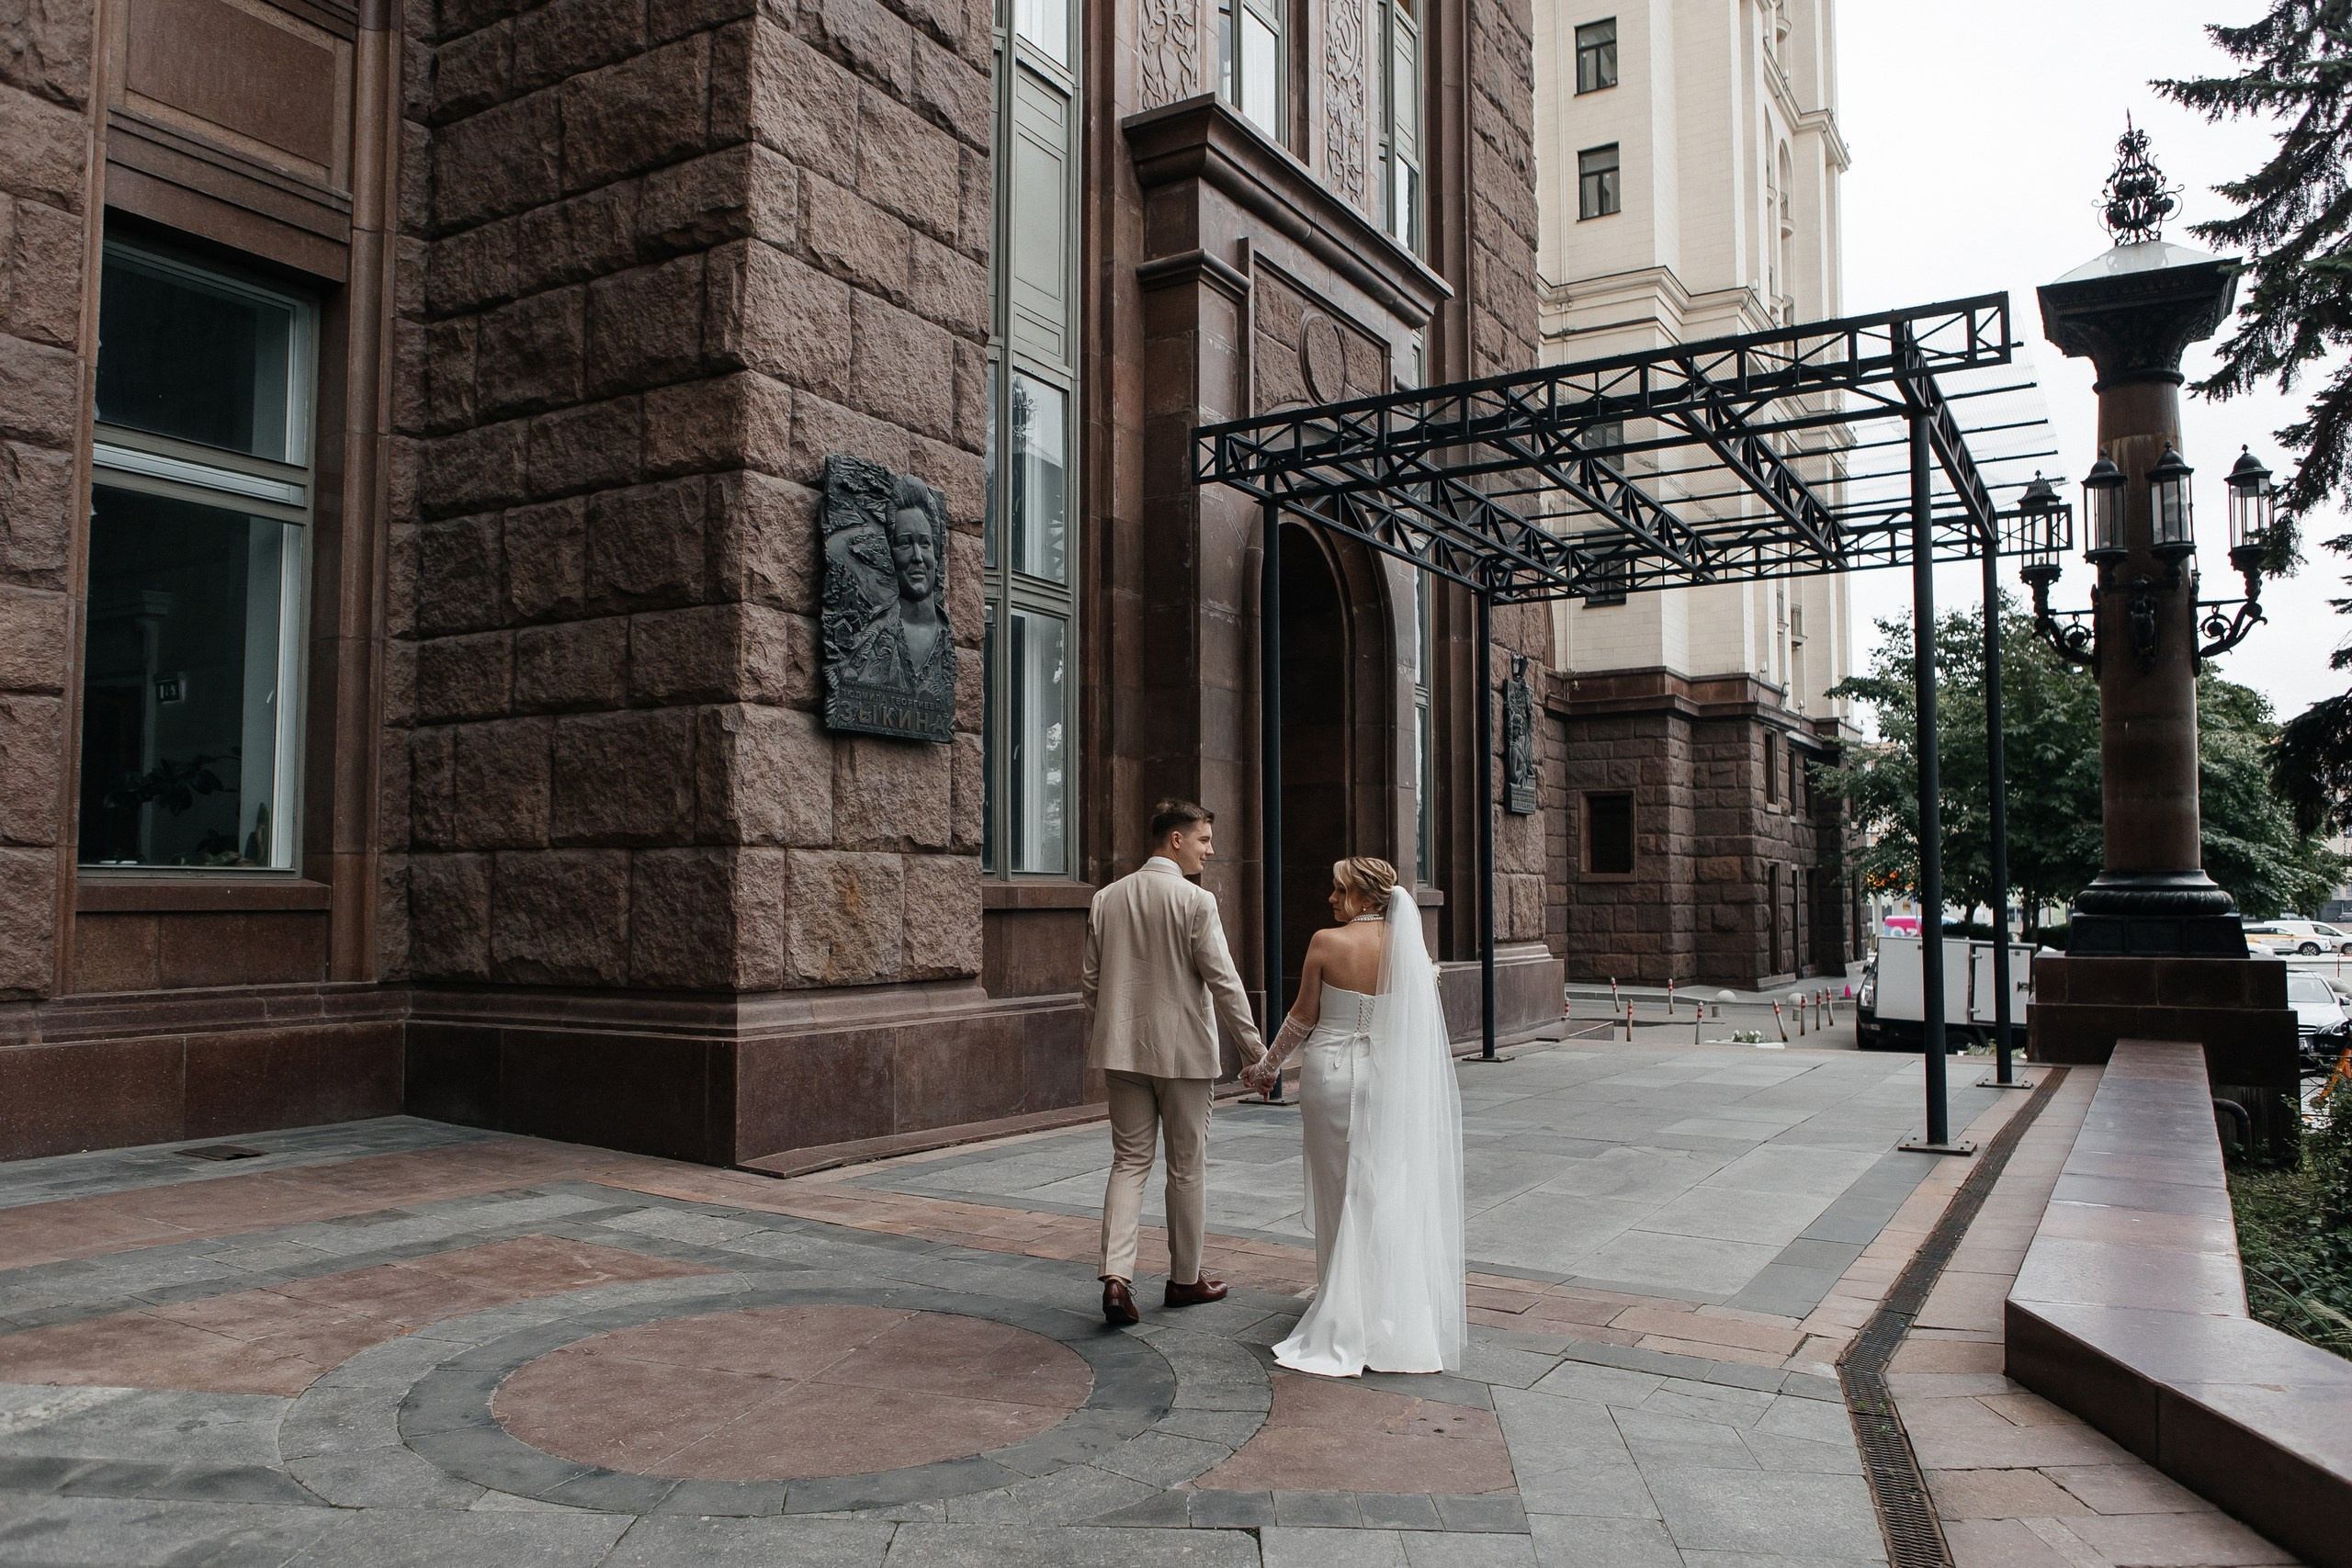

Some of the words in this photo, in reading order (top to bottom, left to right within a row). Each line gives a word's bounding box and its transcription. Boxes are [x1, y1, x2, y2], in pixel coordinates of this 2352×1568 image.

[840, 689, 888, 704] ЛЮДМИЛА
[890, 695, 946, 711] ГЕОРГИЕВНА
[840, 700, 947, 735] ЗЫКИНА
